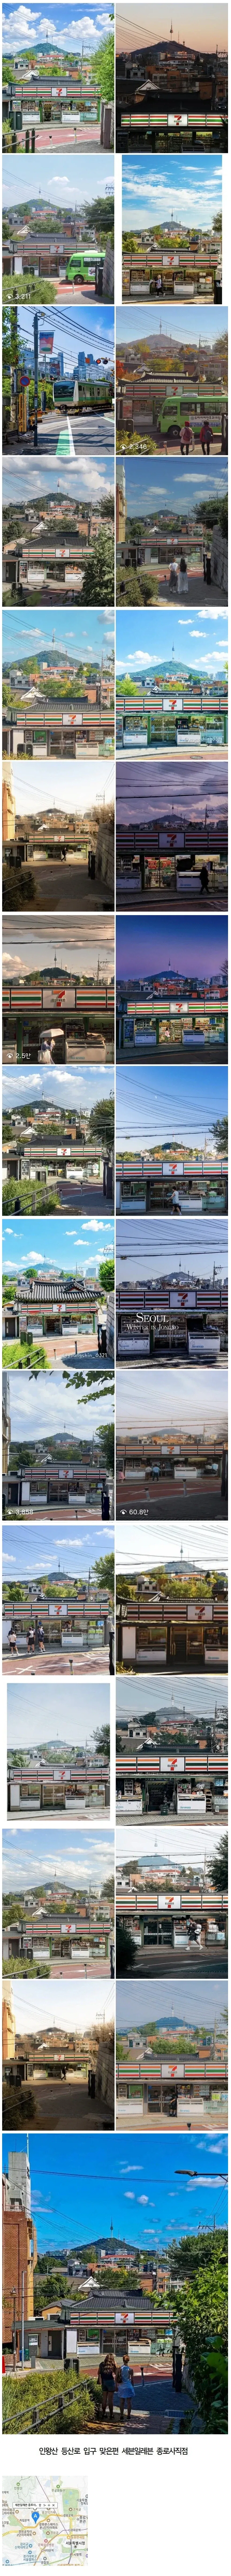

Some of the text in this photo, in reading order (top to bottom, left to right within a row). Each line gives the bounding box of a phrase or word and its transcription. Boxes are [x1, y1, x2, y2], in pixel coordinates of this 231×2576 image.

[174, 115, 181, 125] 7
[168, 256, 174, 265] 7
[172, 387, 178, 395] 7
[169, 700, 176, 710] 7
[69, 715, 76, 724] 7
[167, 834, 176, 847] 7
[53, 990, 65, 1006] 7
[176, 1004, 182, 1012] 7
[169, 1164, 177, 1174] 7
[178, 1293, 188, 1306] 7
[55, 1605, 61, 1615] 7
[196, 1607, 205, 1619] 7
[168, 1758, 177, 1770] 7
[59, 1771, 65, 1779] 7
[165, 1897, 173, 1908] 7
[168, 2065, 177, 2077] 7
[121, 2313, 128, 2323] 7
